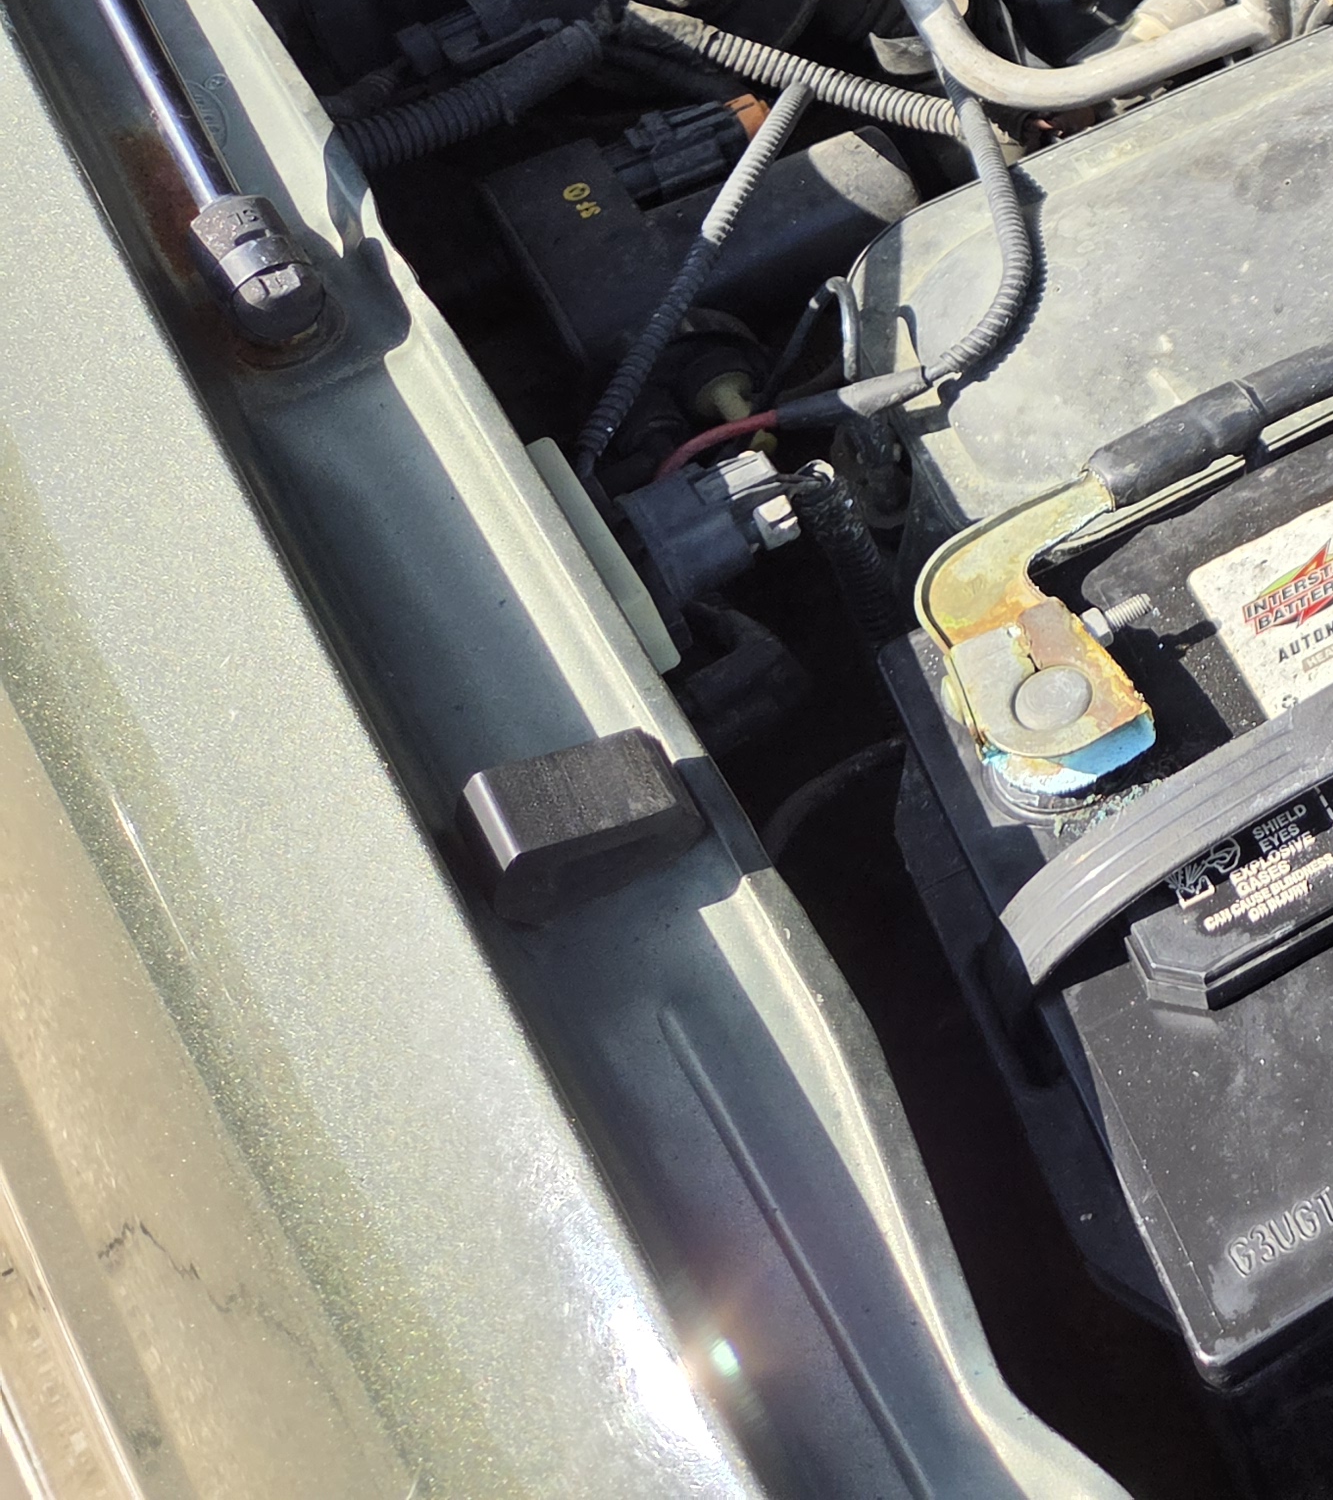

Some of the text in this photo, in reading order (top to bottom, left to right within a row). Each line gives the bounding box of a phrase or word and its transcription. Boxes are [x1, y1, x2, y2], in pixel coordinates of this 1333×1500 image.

[1252, 802, 1307, 840] SHIELD
[1259, 822, 1300, 853] EYES
[1229, 829, 1316, 886] EXPLOSIVE
[1235, 857, 1291, 897] GASES
[1203, 905, 1232, 932] CAN
[1230, 885, 1271, 917] CAUSE
[1247, 901, 1268, 923] OR
